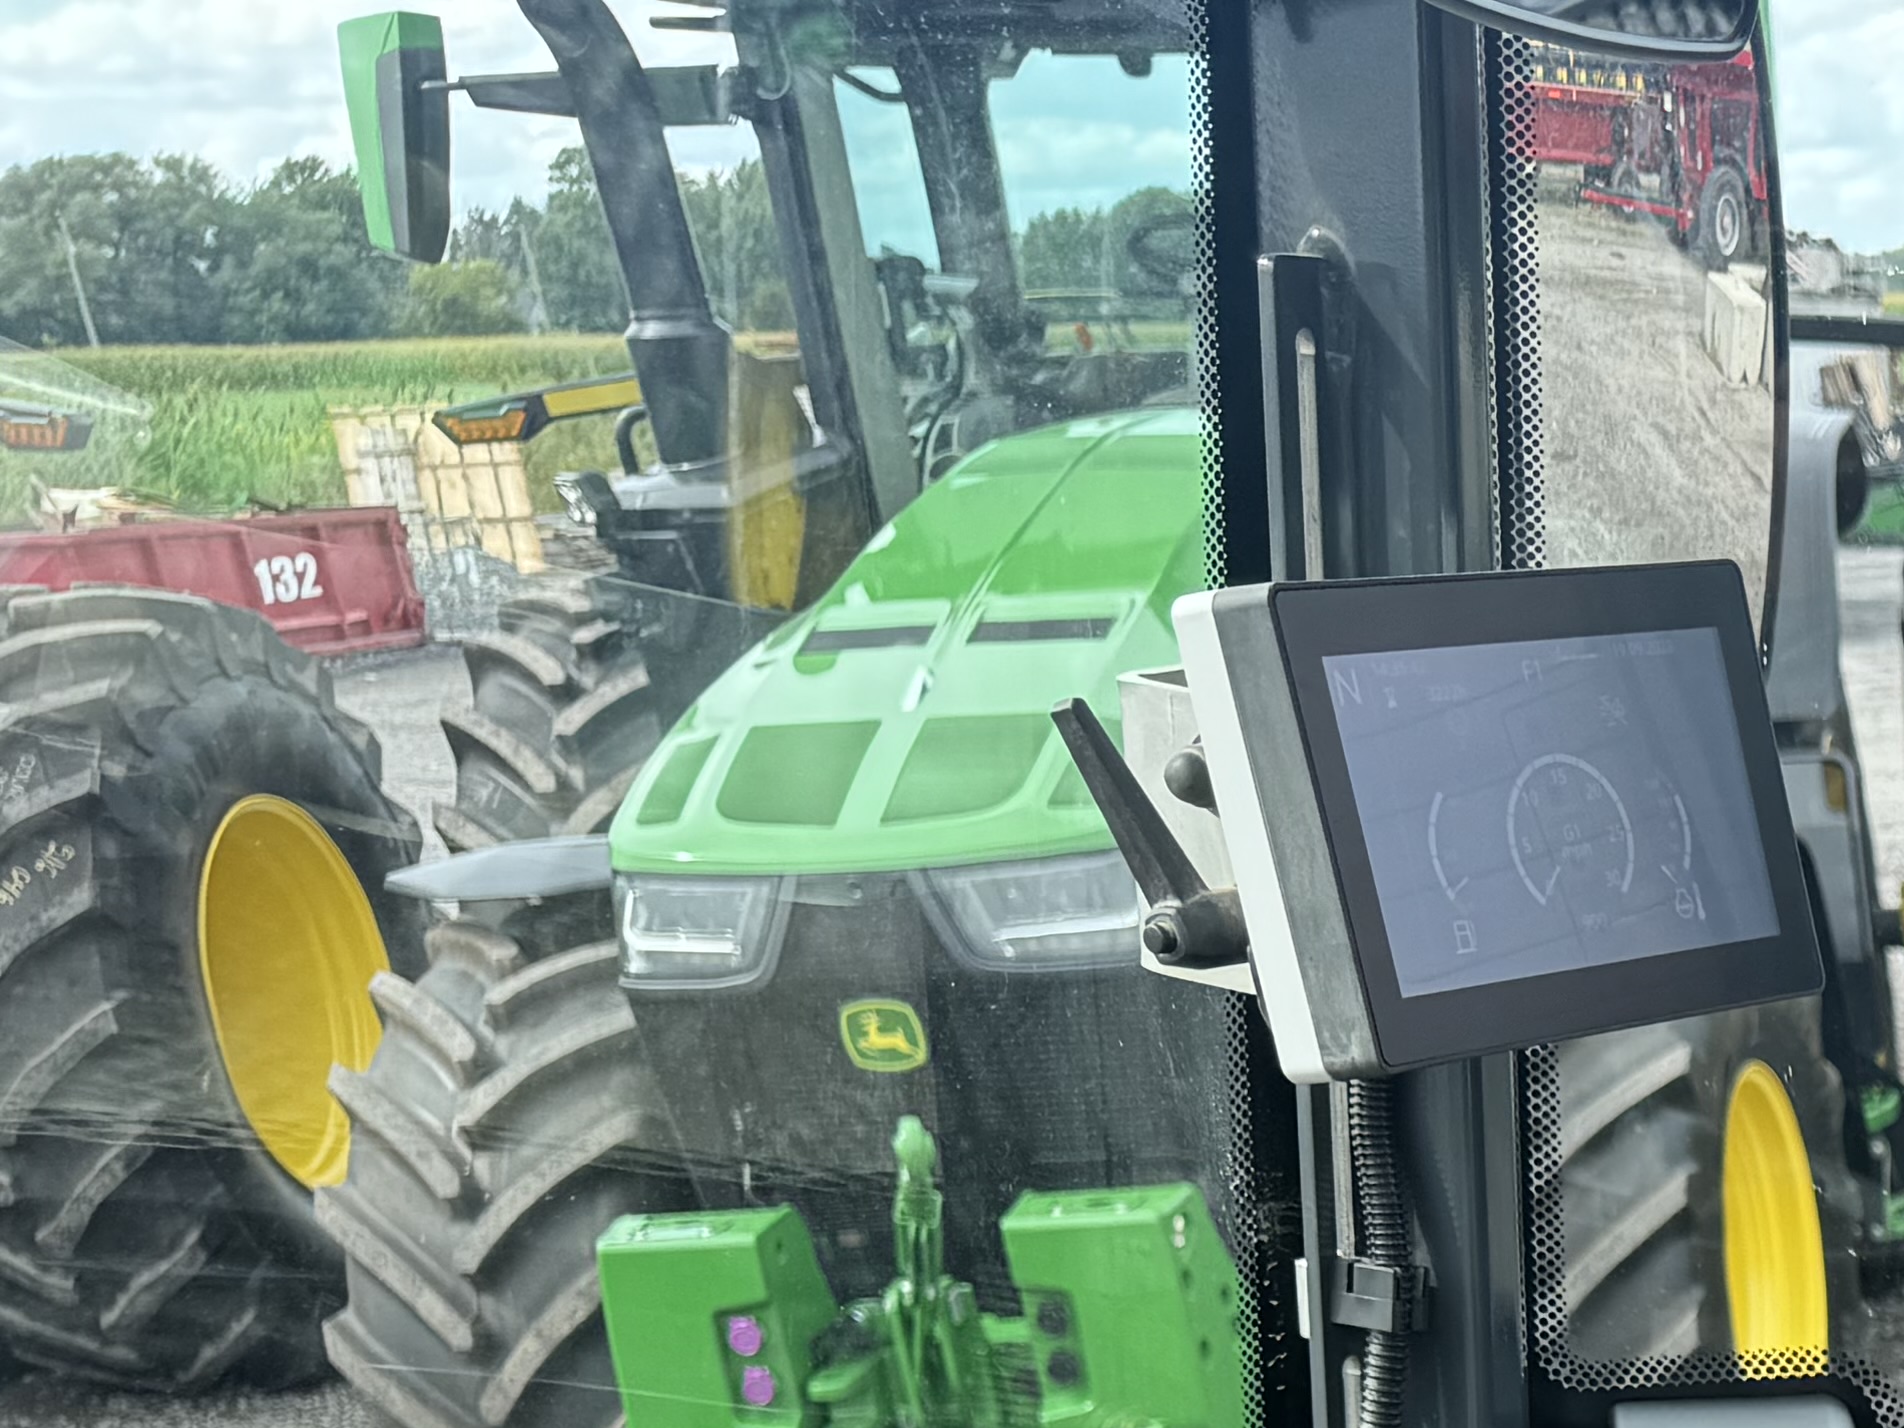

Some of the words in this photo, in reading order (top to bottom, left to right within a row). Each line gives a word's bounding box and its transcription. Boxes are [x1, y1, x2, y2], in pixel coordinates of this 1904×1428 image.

[253, 551, 323, 605] 132
[1333, 668, 1362, 706] N
[1550, 768, 1567, 785] 15
[1521, 837, 1532, 853] 5
